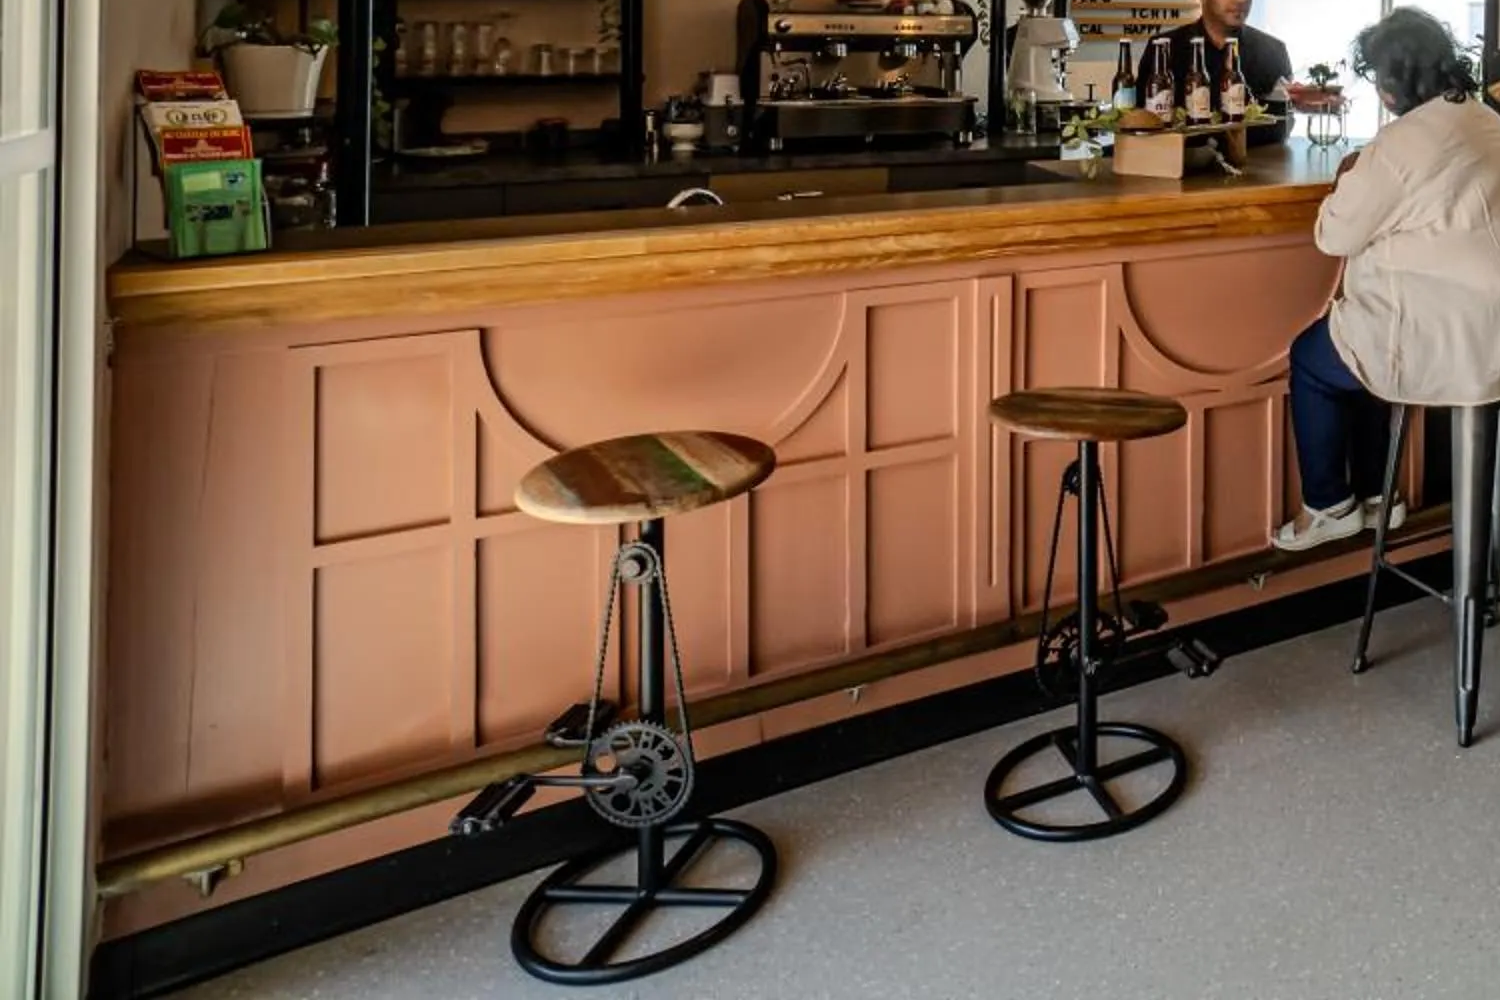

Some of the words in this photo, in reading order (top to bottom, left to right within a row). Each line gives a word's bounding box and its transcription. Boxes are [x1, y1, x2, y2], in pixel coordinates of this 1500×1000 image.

[1131, 8, 1180, 19] TCHIN
[1079, 24, 1104, 34] CAL
[1123, 24, 1162, 35] HAPPY
